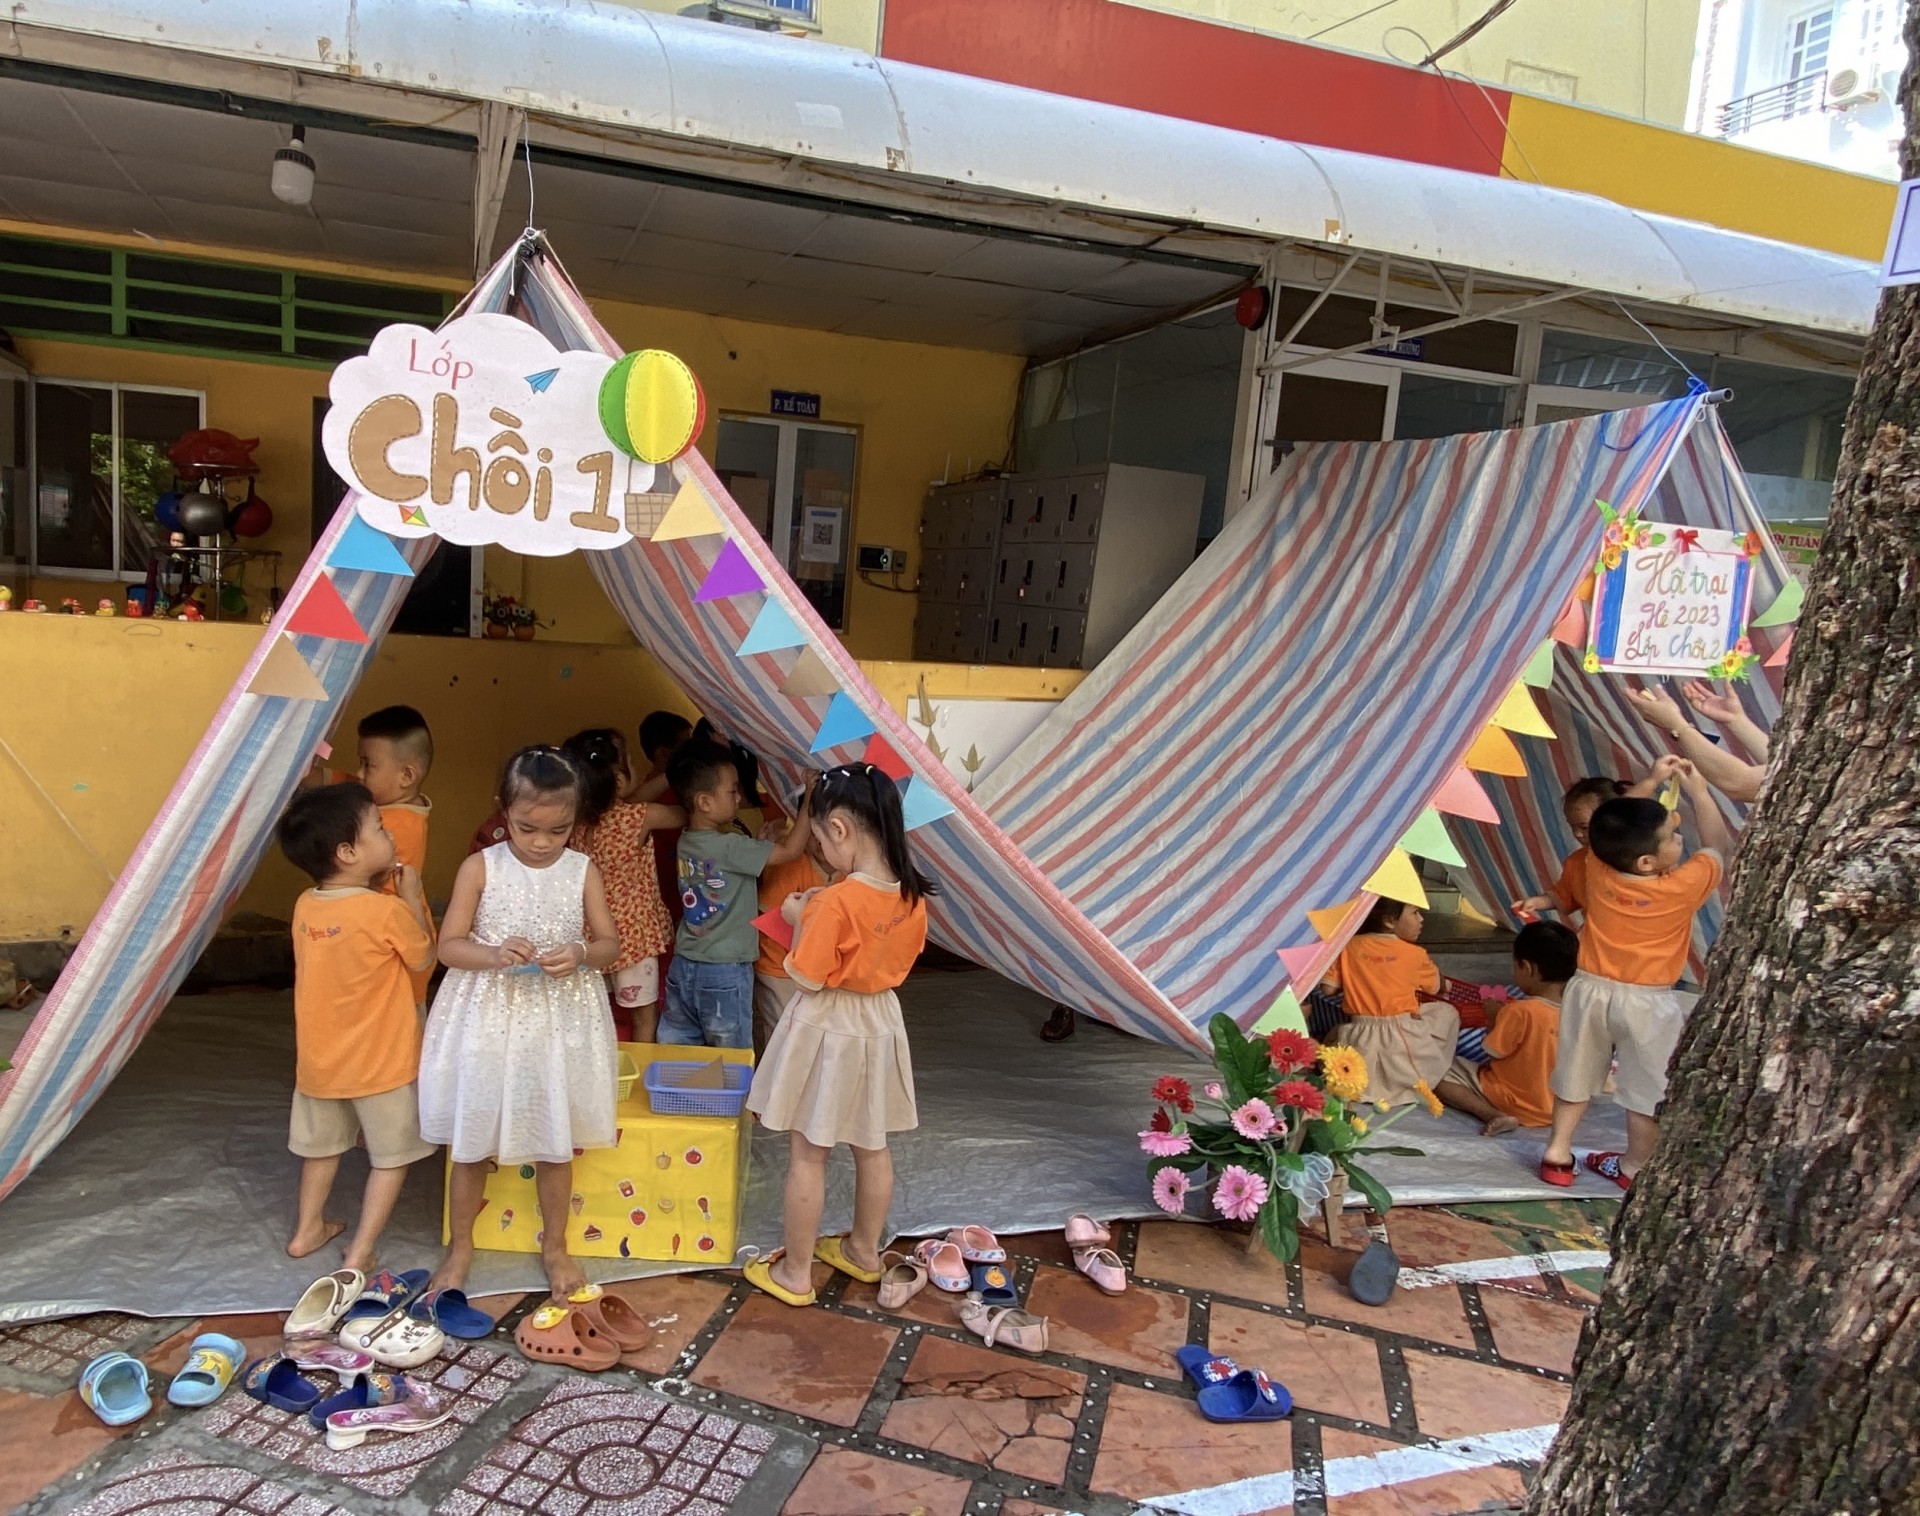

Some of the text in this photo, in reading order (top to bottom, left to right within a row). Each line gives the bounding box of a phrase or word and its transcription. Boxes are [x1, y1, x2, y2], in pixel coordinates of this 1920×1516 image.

[408, 338, 474, 390] Lớp
[348, 391, 620, 533] Chồi 1
[1634, 550, 1728, 600] Hội trại
[1673, 605, 1720, 627] 2023
[1624, 621, 1660, 667] Lớp
[1709, 639, 1721, 660] 2
